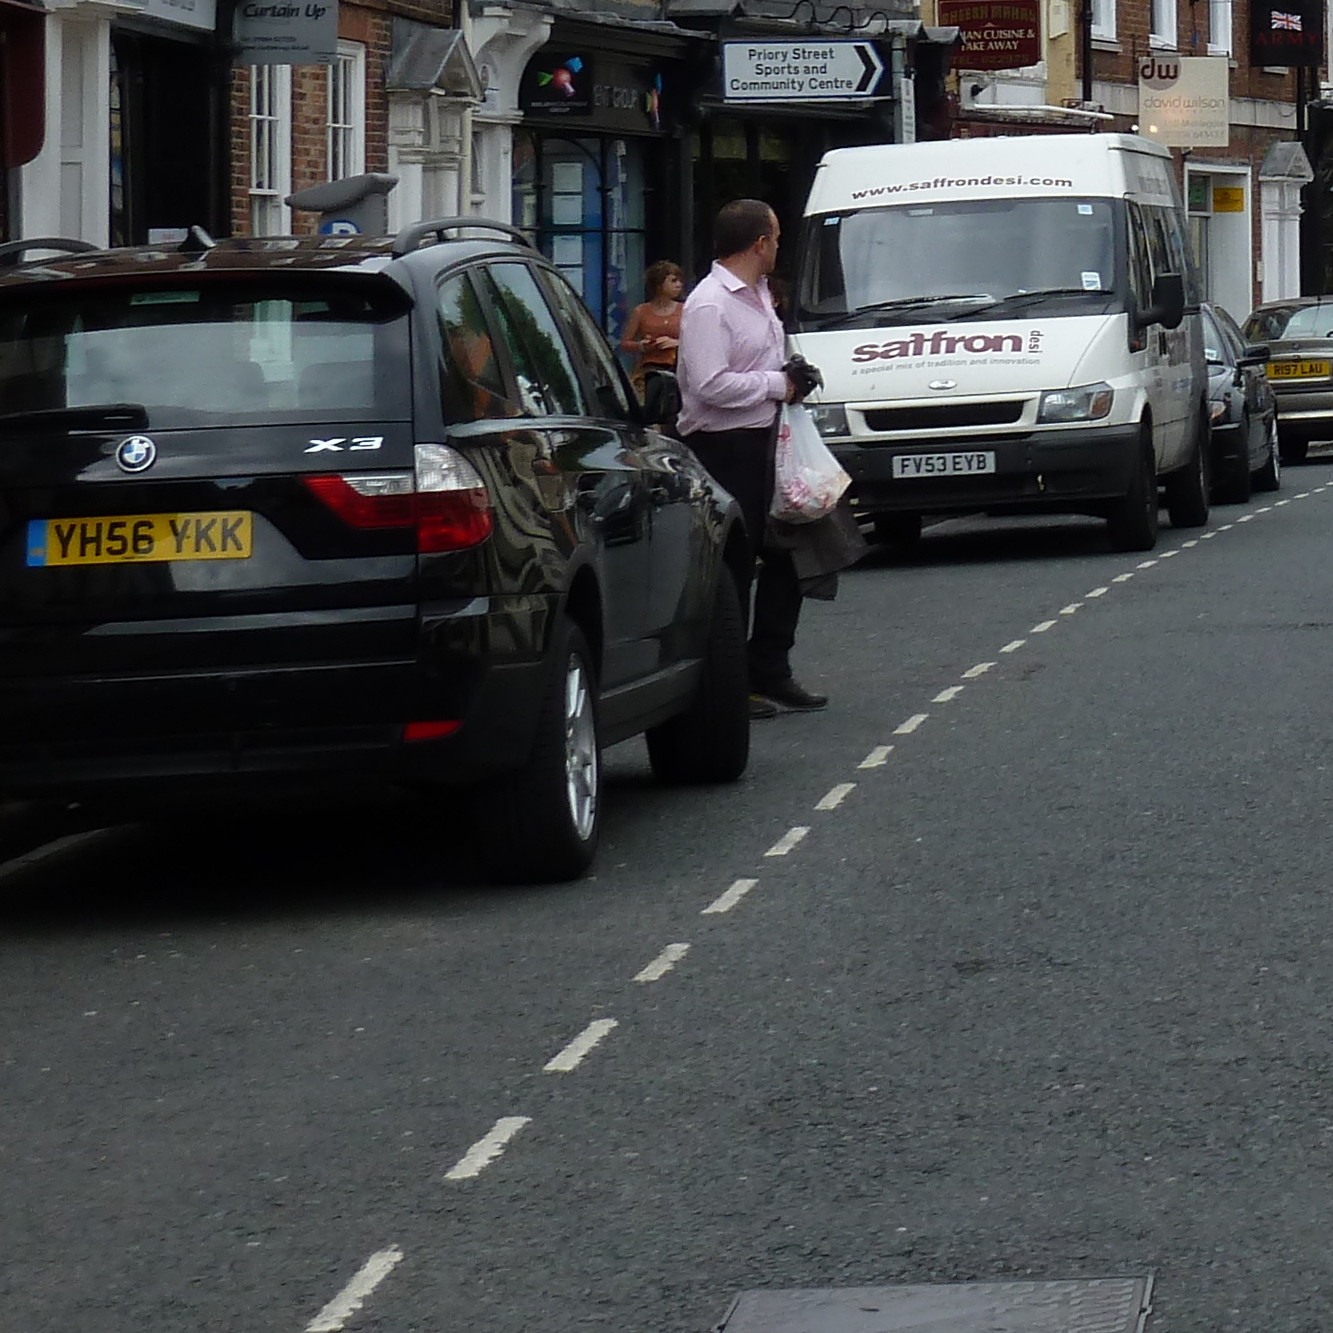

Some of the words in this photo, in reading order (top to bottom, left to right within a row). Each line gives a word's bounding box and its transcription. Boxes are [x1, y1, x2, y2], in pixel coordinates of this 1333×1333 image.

[243, 2, 300, 18] Curtain
[305, 4, 326, 20] Up
[984, 29, 1025, 40] CUISINE
[1027, 29, 1036, 39] &
[1255, 31, 1319, 46] ARMY
[988, 40, 1019, 51] AWAY
[748, 49, 788, 62] Priory
[792, 48, 835, 60] Street
[755, 64, 800, 78] Sports
[803, 63, 827, 75] and
[1140, 58, 1178, 79] dw
[730, 79, 804, 92] Community
[808, 77, 853, 89] Centre
[1144, 96, 1181, 108] david
[1183, 96, 1225, 108] wilson
[851, 175, 1073, 199] www.saffrondesi.com
[851, 330, 1022, 363] saffron
[1028, 330, 1044, 354] desi
[860, 364, 894, 375] special
[927, 358, 968, 368] tradition
[990, 357, 1041, 365] innovation
[1273, 363, 1298, 375] R197
[1301, 362, 1323, 374] LAU
[303, 437, 385, 453] X3
[901, 457, 947, 474] FV53
[952, 454, 987, 471] EYB
[55, 521, 155, 559] YH56
[170, 516, 244, 554] YKK
